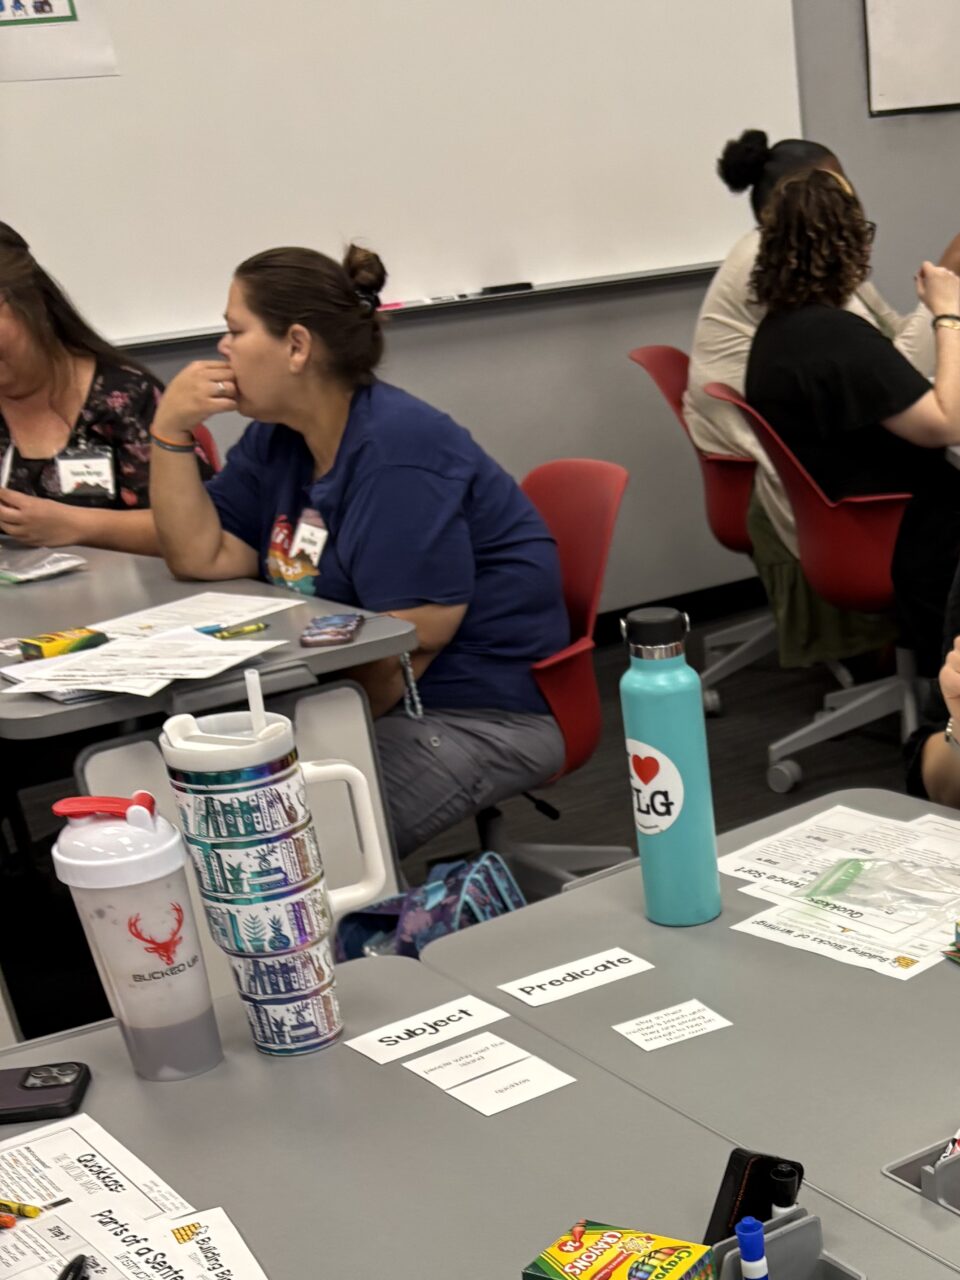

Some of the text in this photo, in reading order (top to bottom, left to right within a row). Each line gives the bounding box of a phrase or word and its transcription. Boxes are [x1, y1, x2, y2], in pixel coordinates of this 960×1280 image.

[794, 931, 811, 939] of
[814, 936, 847, 951] Blocks
[848, 947, 889, 963] Building
[132, 962, 186, 983] BUCKED
[517, 954, 633, 997] Predicate
[377, 1008, 474, 1048] Subject
[91, 1209, 129, 1236] Parts
[122, 1235, 148, 1247] of
[135, 1247, 154, 1256] a
[562, 1241, 580, 1252] 24
[195, 1236, 223, 1271] Building
[564, 1231, 622, 1275] CRAYONS
